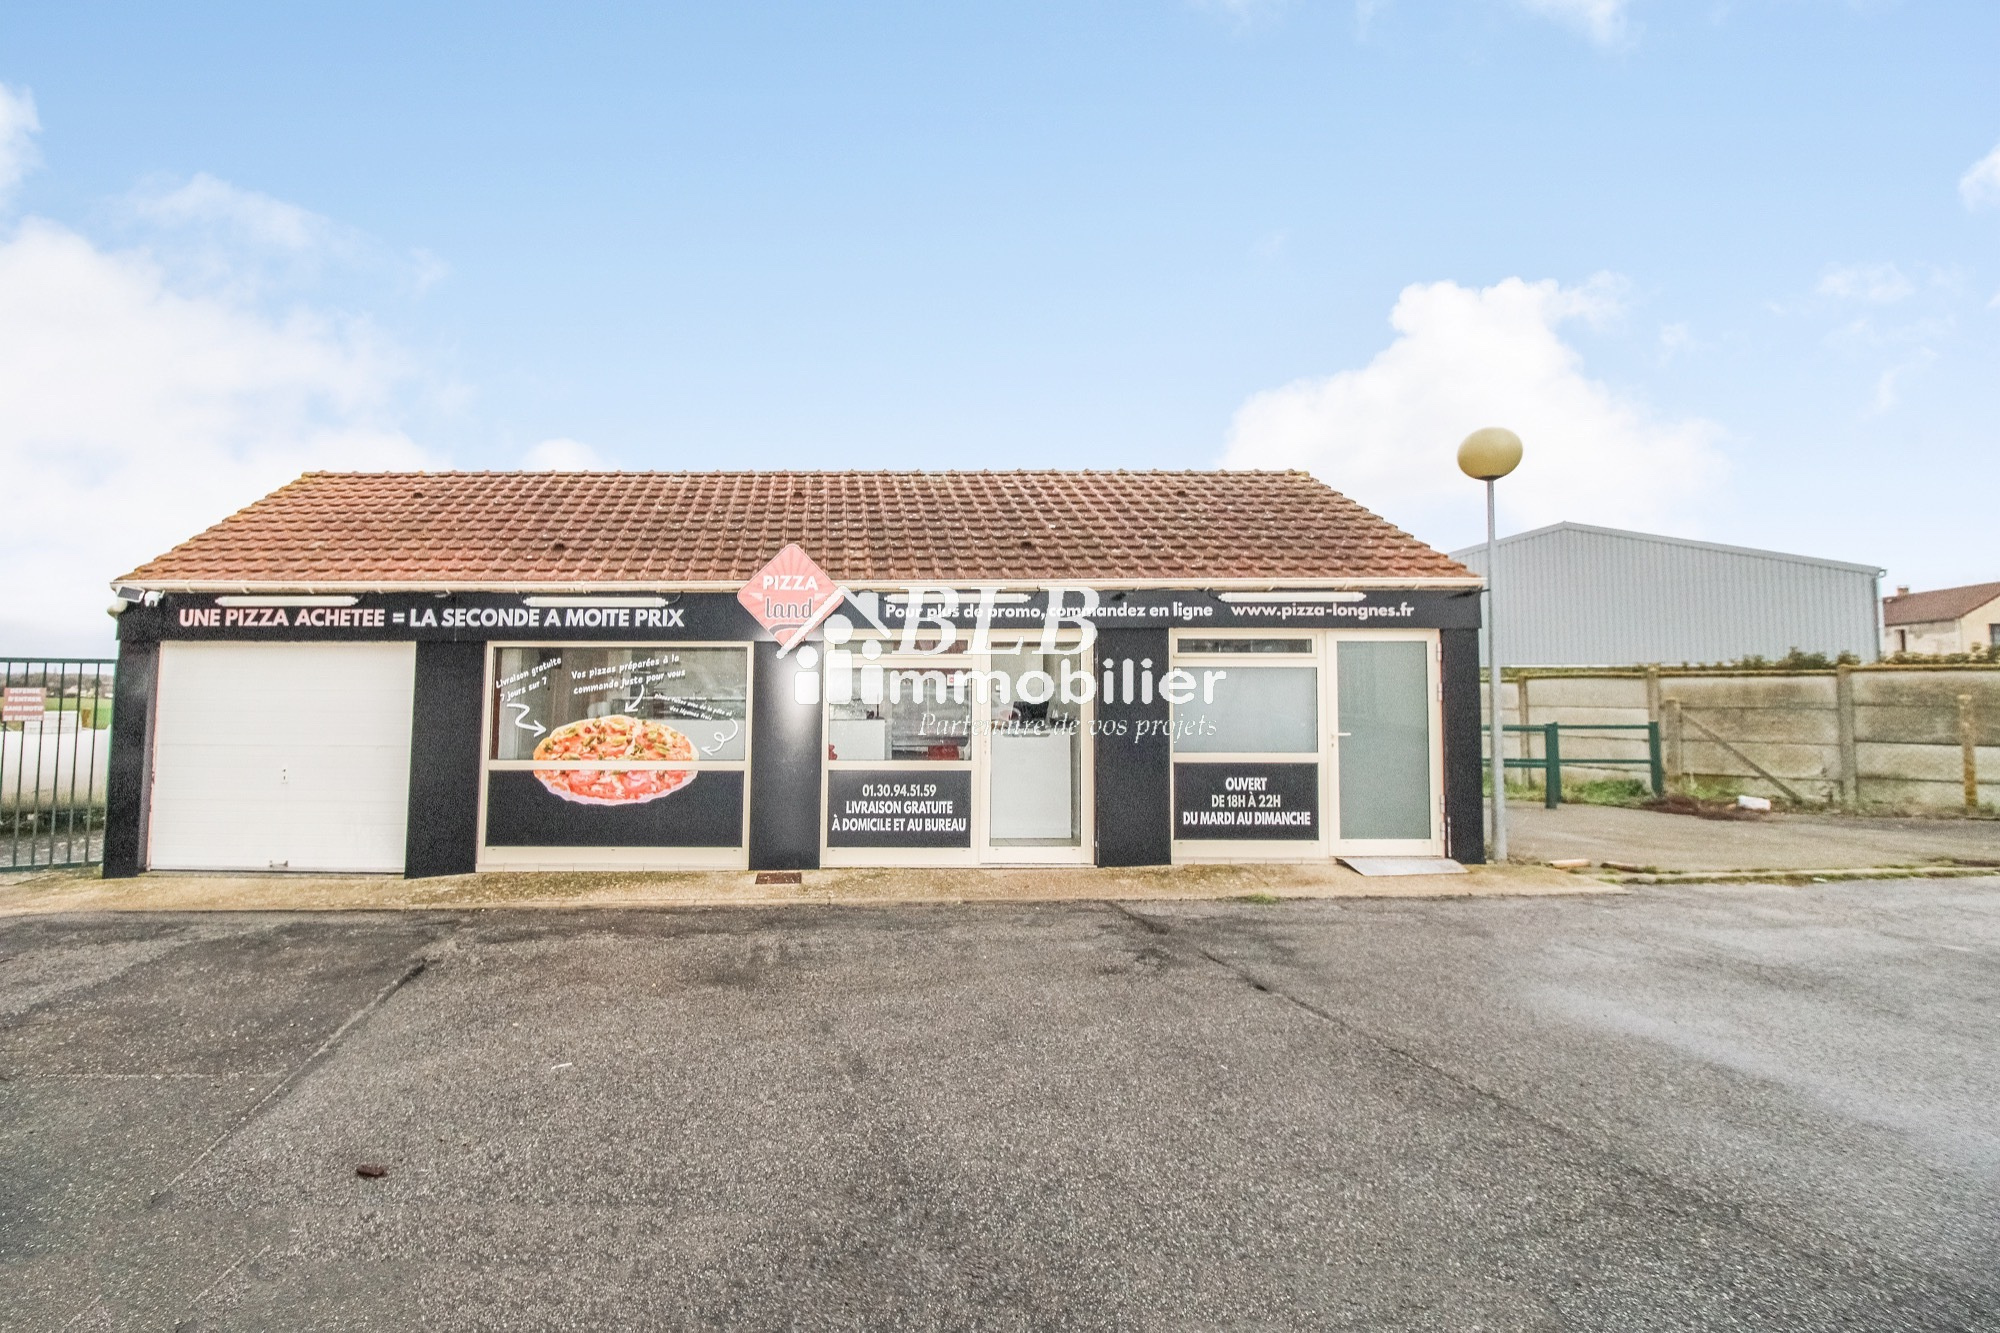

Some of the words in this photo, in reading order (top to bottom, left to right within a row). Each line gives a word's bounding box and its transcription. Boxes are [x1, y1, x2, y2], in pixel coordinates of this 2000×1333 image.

[762, 575, 818, 590] PIZZA
[179, 608, 220, 627] UNE
[225, 608, 289, 627] PIZZA
[294, 608, 385, 627] ACHETEE
[410, 608, 437, 627] LA
[441, 608, 539, 627] SECONDE
[544, 608, 561, 627] A
[565, 608, 629, 627] MOITE
[635, 608, 684, 627] PRIX
[764, 597, 813, 620] land
[885, 604, 923, 618] Pour
[927, 604, 960, 621] plus
[963, 604, 984, 618] de
[988, 606, 1046, 620] promo,
[1048, 602, 1146, 618] commandez
[1150, 606, 1169, 617] en
[1173, 602, 1213, 621] ligne
[1230, 602, 1414, 620] www.pizza-longnes.fr
[495, 670, 529, 689] Livraison
[531, 657, 562, 677] gratuite
[571, 670, 586, 680] Vos
[589, 666, 616, 679] pizzas
[619, 658, 660, 673] préparées
[663, 655, 669, 664] à
[672, 654, 680, 662] la
[500, 693, 505, 702] 7
[507, 687, 526, 702] jours
[528, 681, 540, 691] sur
[541, 676, 547, 685] 7
[573, 679, 619, 695] commande
[620, 676, 643, 689] juste
[646, 673, 664, 684] pour
[667, 669, 686, 679] vous
[862, 784, 937, 797] 01.30.94.51.59
[1225, 777, 1267, 791] OUVERT
[846, 800, 901, 814] LIVRAISON
[903, 800, 953, 814] GRATUITE
[1211, 794, 1224, 808] DE
[1227, 794, 1245, 808] 18H
[1248, 791, 1256, 808] À
[1259, 794, 1281, 808] 22H
[831, 814, 840, 831] À
[842, 818, 891, 831] DOMICILE
[893, 818, 905, 831] ET
[907, 818, 922, 831] AU
[924, 818, 967, 831] BUREAU
[1183, 811, 1198, 825] DU
[1200, 811, 1235, 825] MARDI
[1236, 811, 1252, 825] AU
[1254, 811, 1311, 825] DIMANCHE
